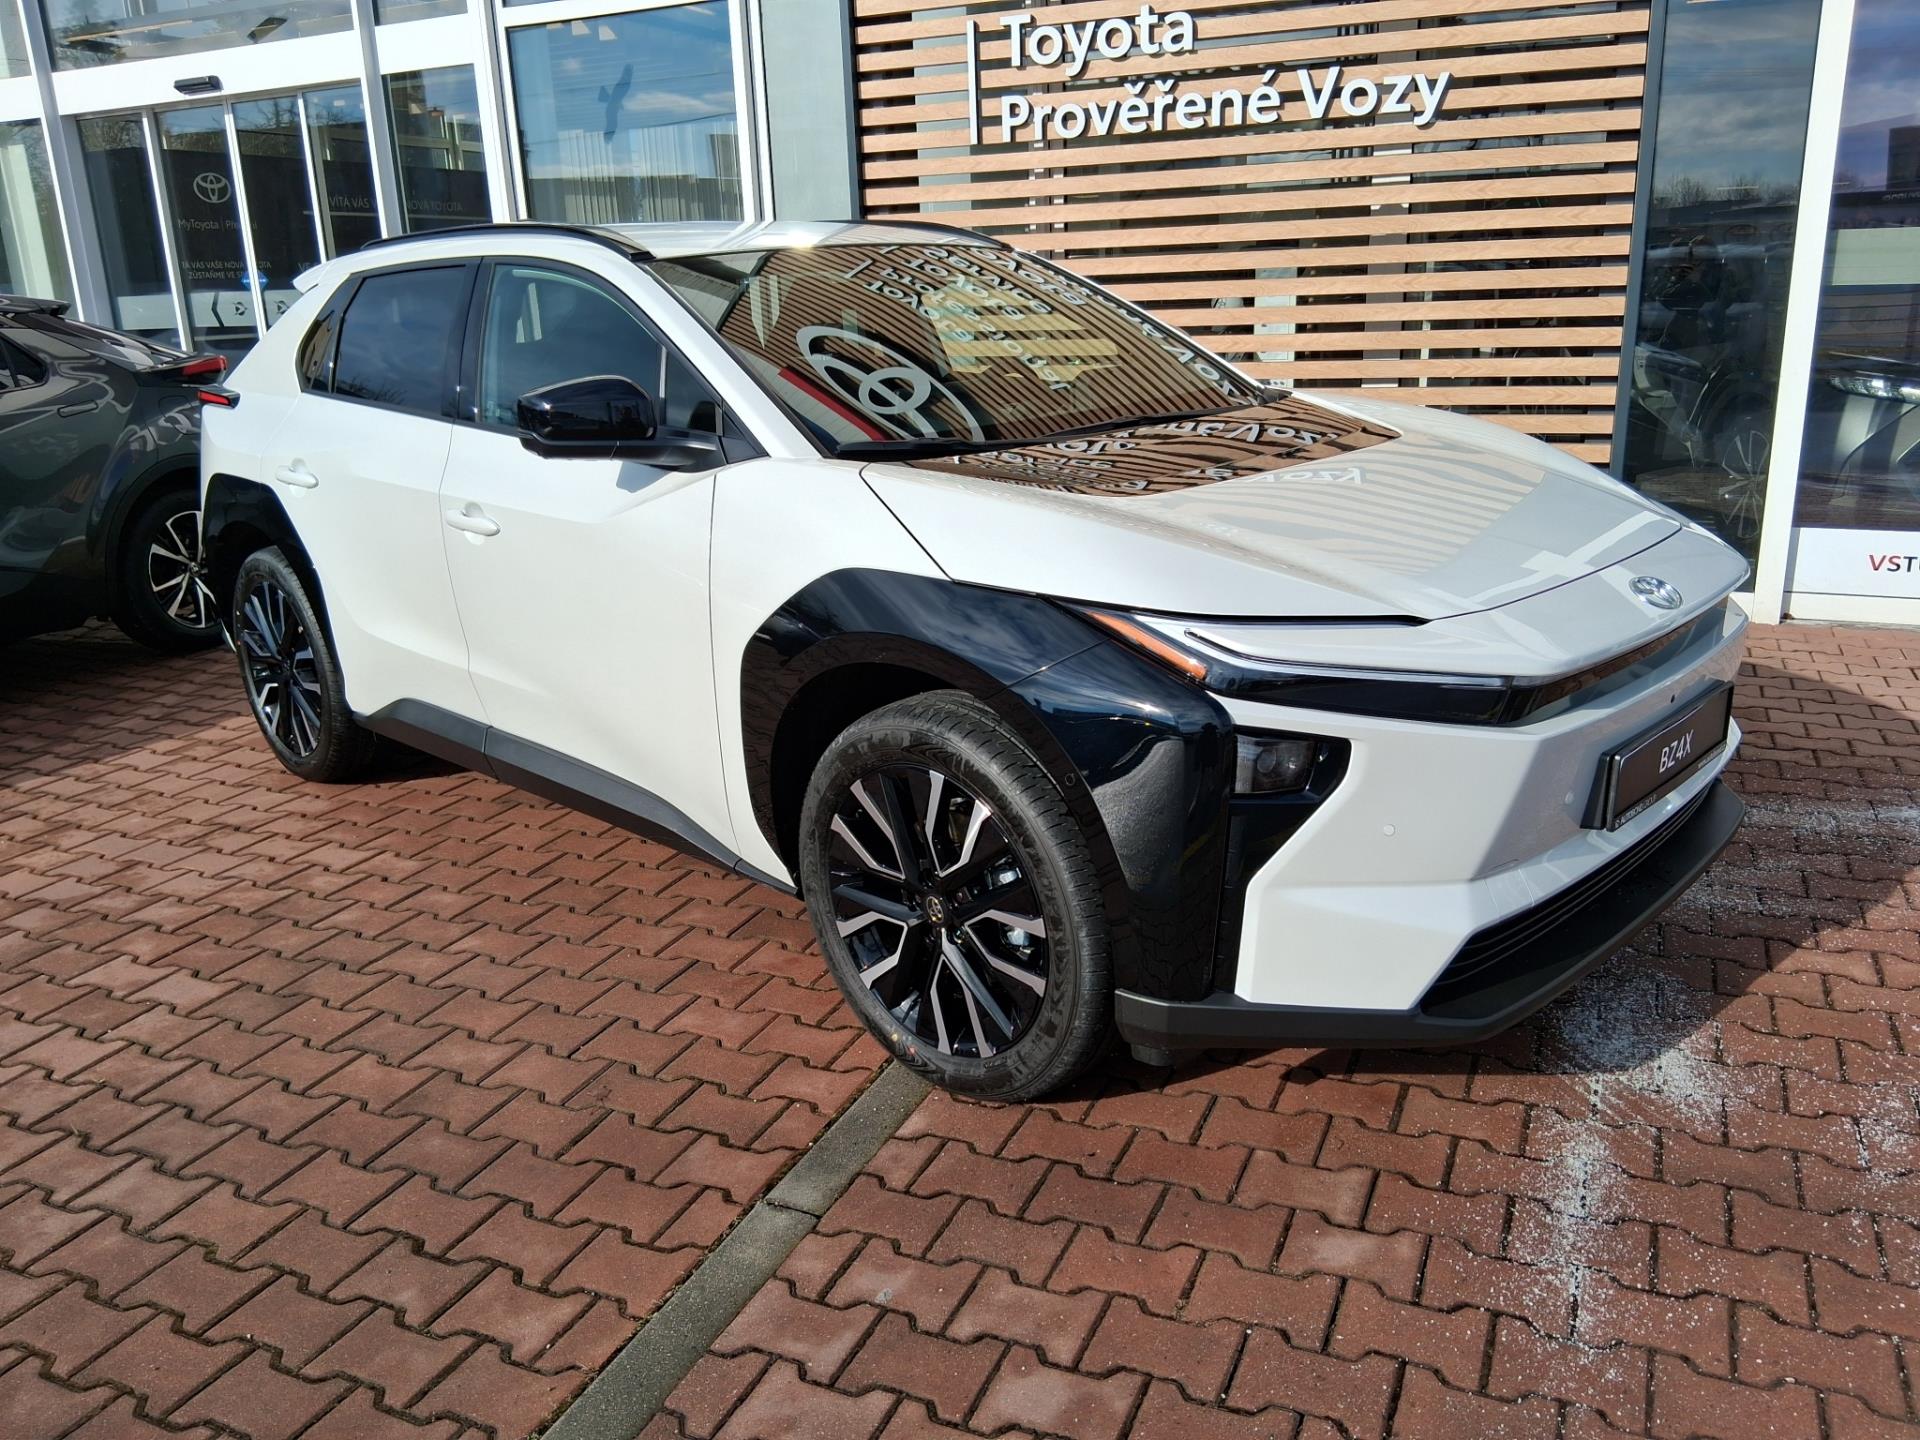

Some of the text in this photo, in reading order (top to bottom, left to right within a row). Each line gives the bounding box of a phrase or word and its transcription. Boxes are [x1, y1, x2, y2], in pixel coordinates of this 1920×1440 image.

[1000, 4, 1196, 77] Toyota
[1000, 65, 1451, 143] Prověřené Vozy
[178, 218, 220, 231] MyToyota
[1868, 553, 1920, 573] VST
[1658, 729, 1694, 774] BZ4X
